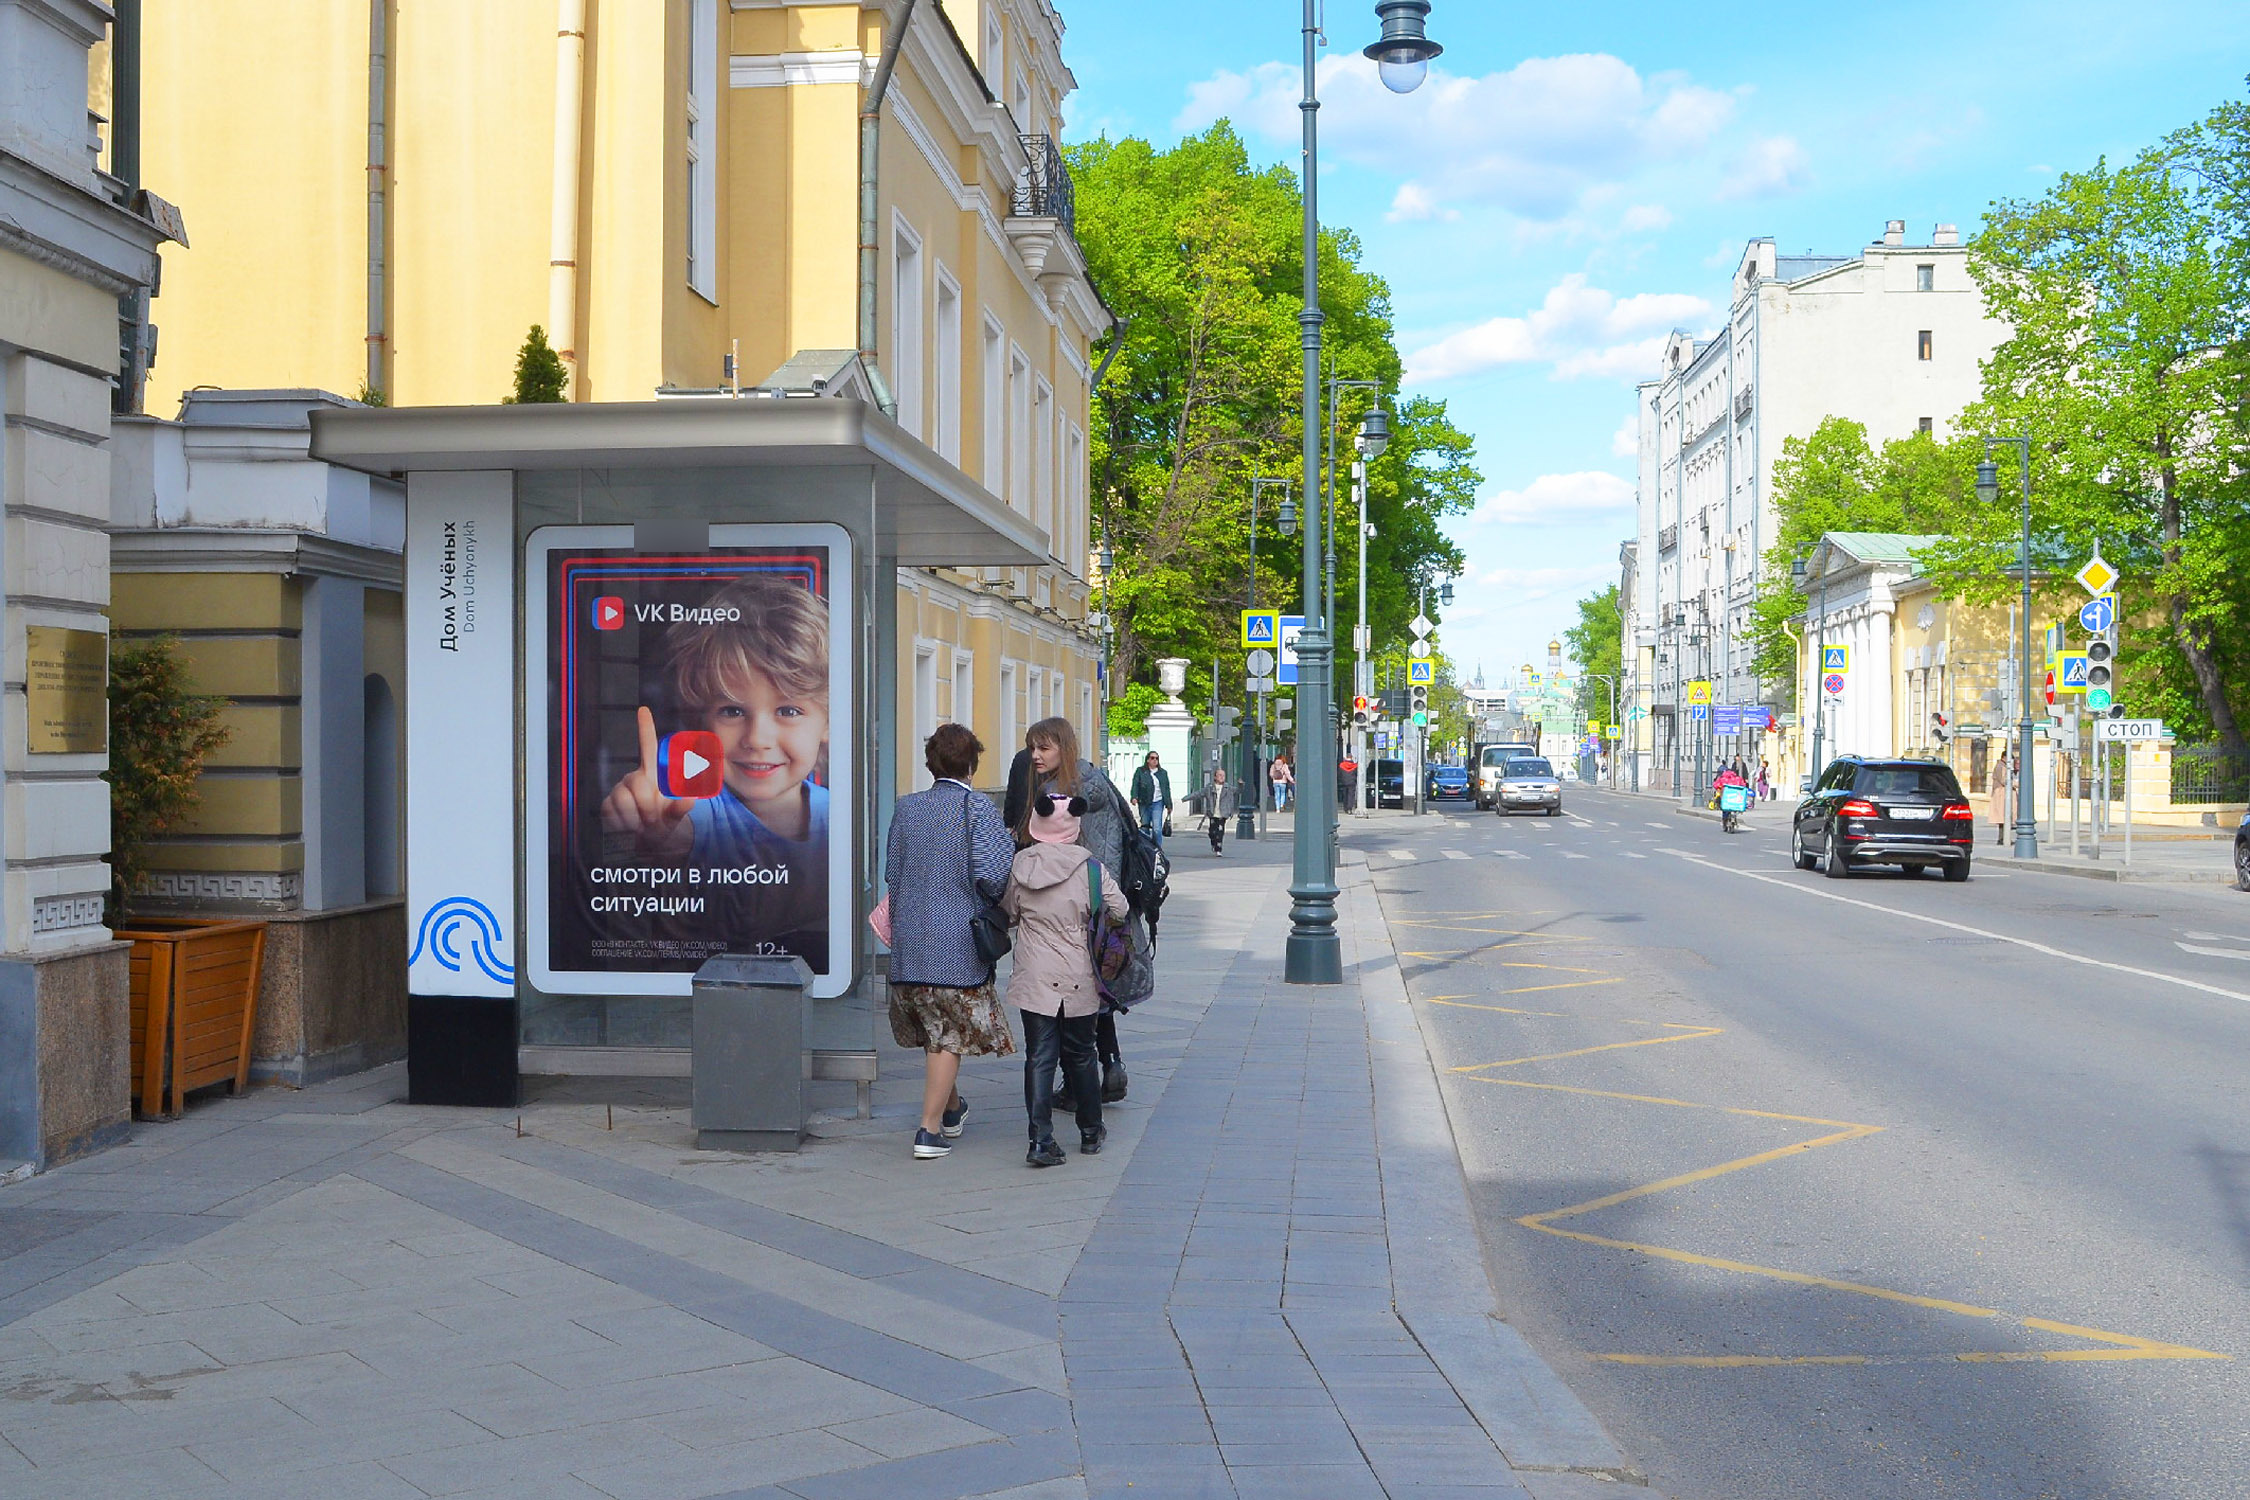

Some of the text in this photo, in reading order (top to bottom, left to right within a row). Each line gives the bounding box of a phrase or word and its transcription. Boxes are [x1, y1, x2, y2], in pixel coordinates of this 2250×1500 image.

[440, 522, 459, 652] Дом Учёных
[463, 521, 477, 632] Dom Uchyonykh
[634, 603, 741, 625] VK Видео
[2108, 723, 2152, 736] СТОП
[590, 864, 789, 888] смотри в любой
[590, 896, 704, 917] ситуации
[755, 942, 788, 956] 12+
